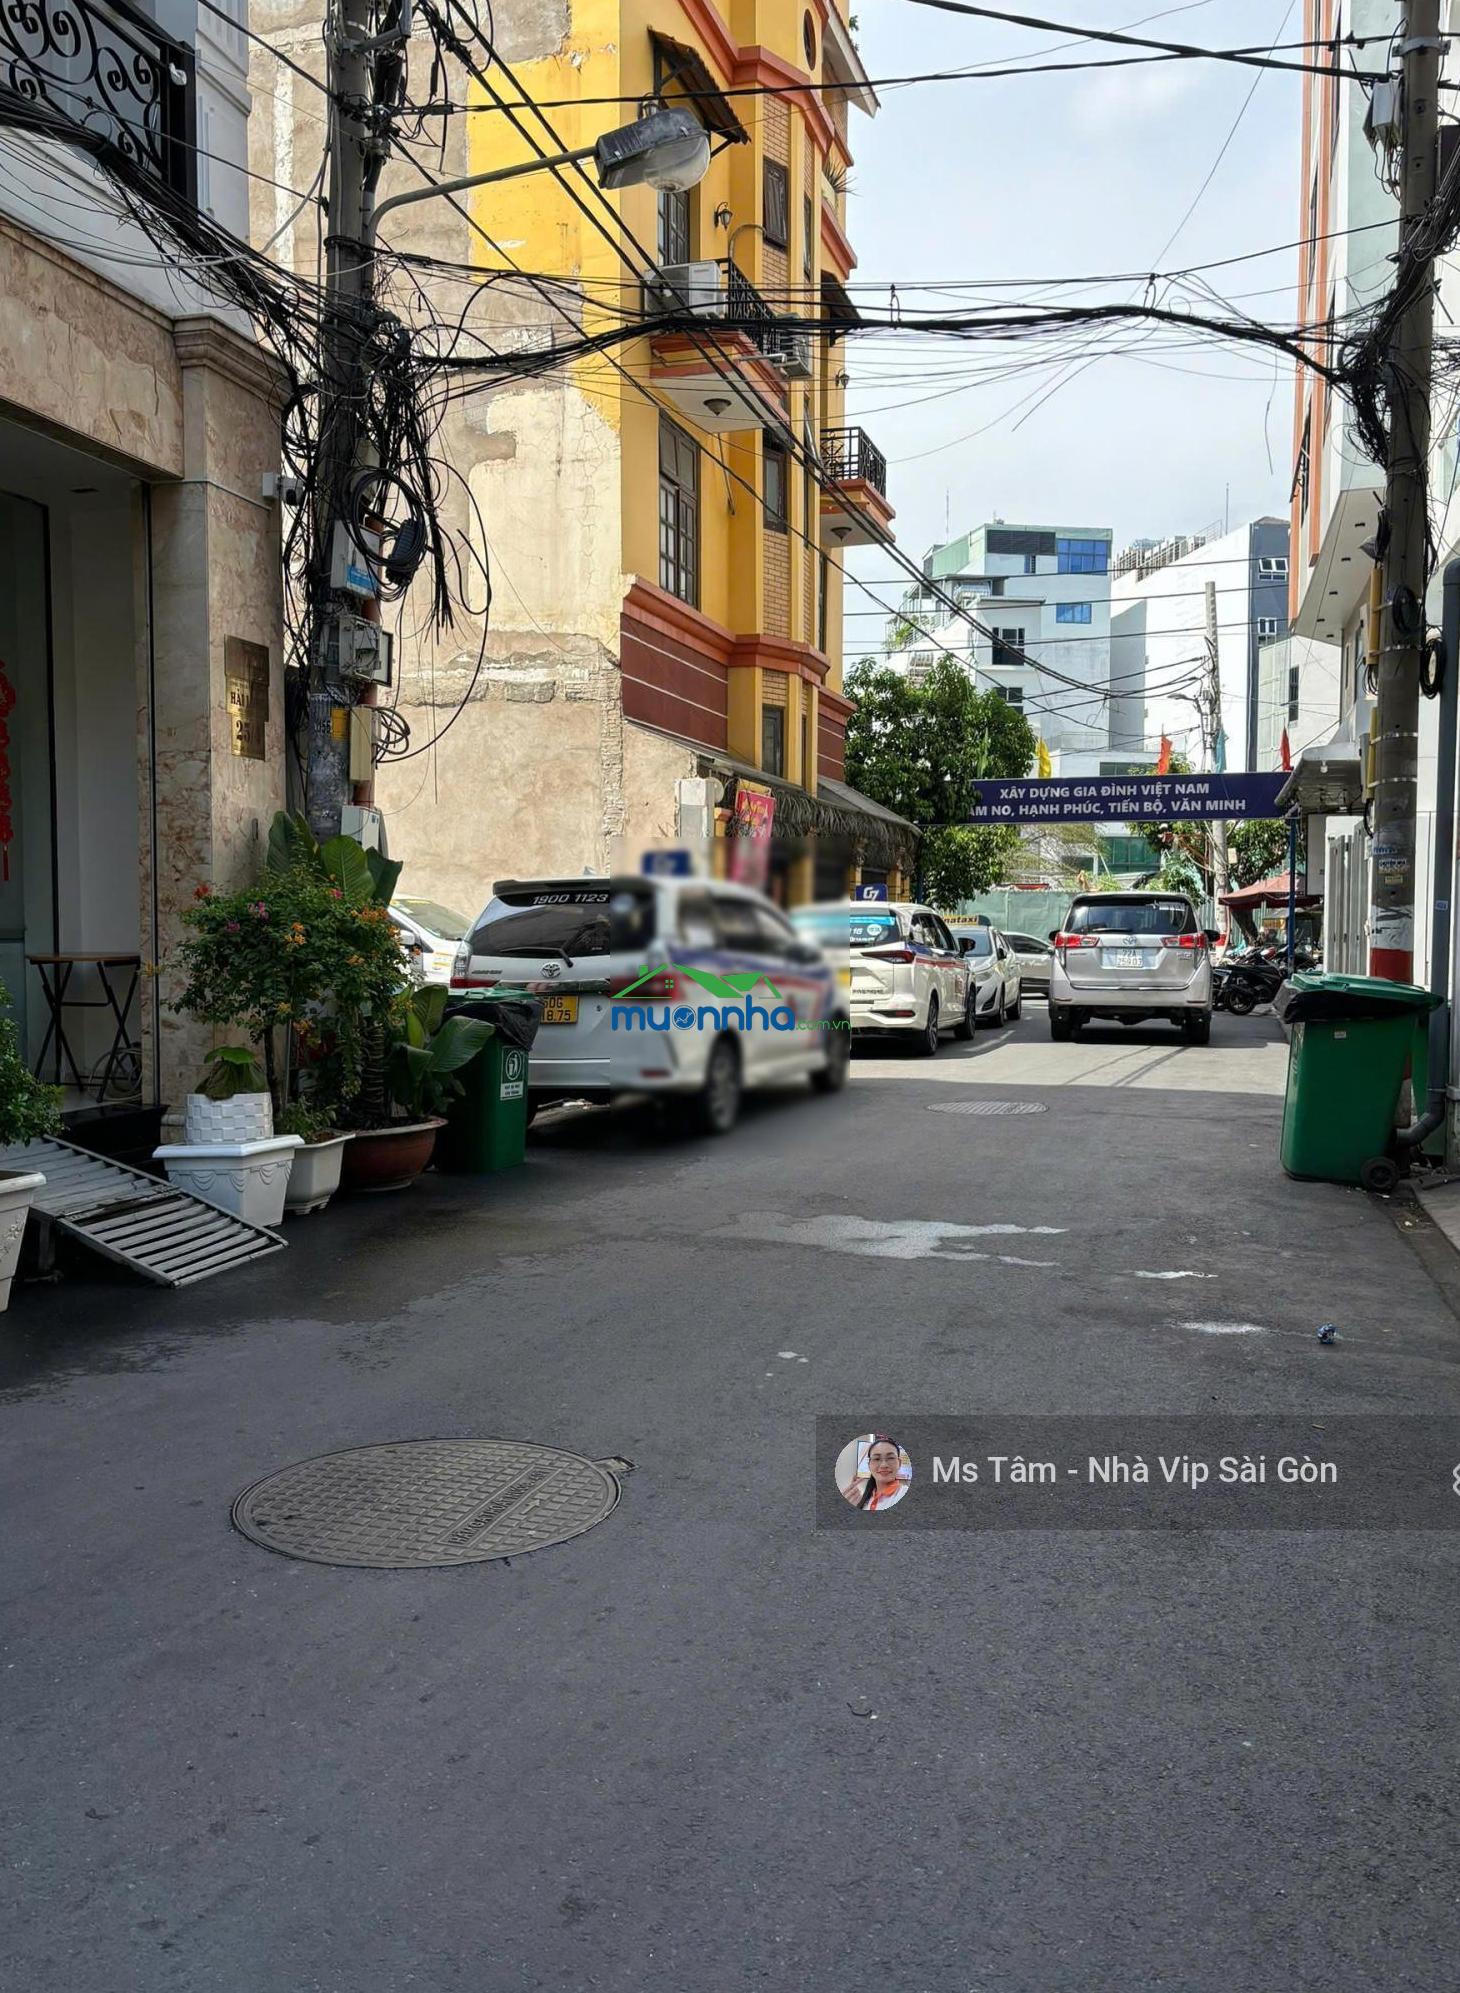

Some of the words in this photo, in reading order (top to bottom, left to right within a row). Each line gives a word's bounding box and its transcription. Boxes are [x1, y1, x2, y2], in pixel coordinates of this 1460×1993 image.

[1000, 786, 1026, 799] XÂY
[1029, 786, 1070, 800] DỰNG
[1073, 786, 1097, 797] GIA
[1100, 783, 1137, 796] ĐÌNH
[1140, 782, 1172, 797] VIỆT
[1175, 783, 1210, 795] NAM
[991, 805, 1015, 817] NO,
[1019, 804, 1061, 817] HẠNH
[1063, 800, 1104, 815] PHÚC,
[1108, 799, 1139, 813] TIẾN
[1143, 799, 1167, 814] BỘ,
[1171, 798, 1201, 812] VĂN
[1205, 799, 1246, 811] MINH
[532, 894, 570, 905] 1900
[574, 894, 609, 903] 1123
